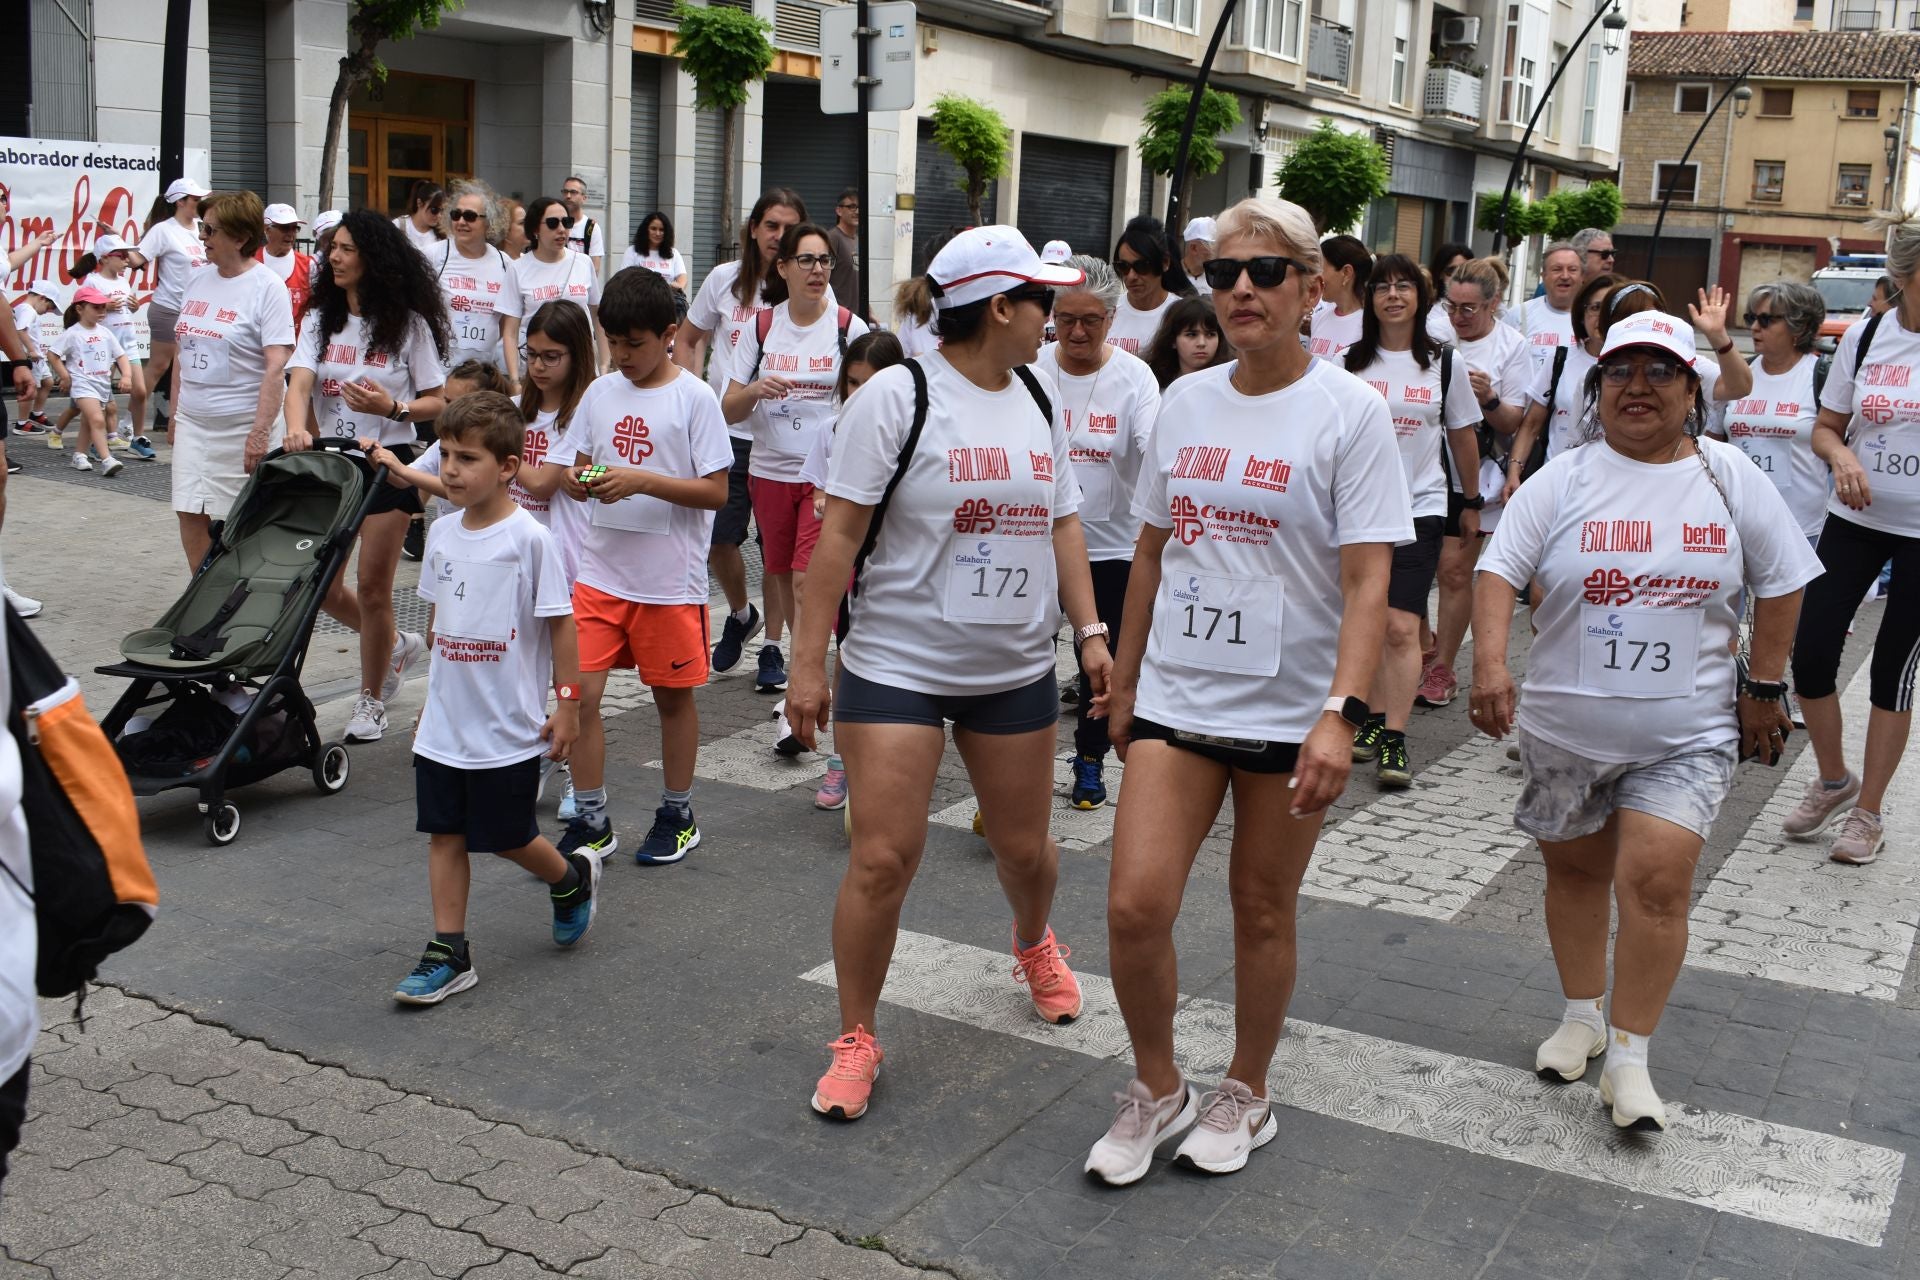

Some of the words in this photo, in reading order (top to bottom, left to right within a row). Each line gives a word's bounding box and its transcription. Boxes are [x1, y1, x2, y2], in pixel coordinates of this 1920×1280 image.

[461, 325, 487, 341] 101
[94, 351, 106, 362] 49
[191, 353, 209, 370] 15
[809, 355, 833, 368] berlin
[1405, 385, 1432, 400] berlin
[1776, 402, 1800, 414] berlin
[335, 418, 356, 439] 83
[792, 417, 802, 431] 6
[1089, 413, 1117, 430] berlin
[1752, 425, 1797, 436] Cáritas
[1068, 448, 1112, 458] áritas
[954, 447, 1011, 482] SOLIDARIA
[1030, 450, 1053, 475] berlin
[1173, 446, 1231, 482] SOLIDARIA
[1244, 454, 1291, 485] berlin
[1872, 451, 1920, 477] 180
[1242, 478, 1286, 493] PACKAGING
[996, 503, 1049, 518] Cárita
[1201, 504, 1280, 529] Cáritas
[1206, 521, 1273, 539] Interparroquial
[1580, 521, 1588, 553] MARCHA
[1587, 520, 1652, 553] SOLIDARIA
[1683, 523, 1726, 546] berlin
[1211, 533, 1223, 541] de
[1226, 534, 1269, 546] Calahorra
[1683, 546, 1728, 554] PACKAGING
[955, 554, 991, 564] Calahorra
[971, 566, 1029, 598] 172
[1633, 574, 1720, 591] Cáritas
[454, 581, 466, 601] 4
[1173, 588, 1200, 602] Calahorra
[1639, 589, 1711, 600] Interparroquial
[1182, 604, 1247, 645] 171
[1587, 625, 1623, 637] Calahorra
[448, 651, 500, 663] alahorra
[1603, 638, 1671, 673] 173
